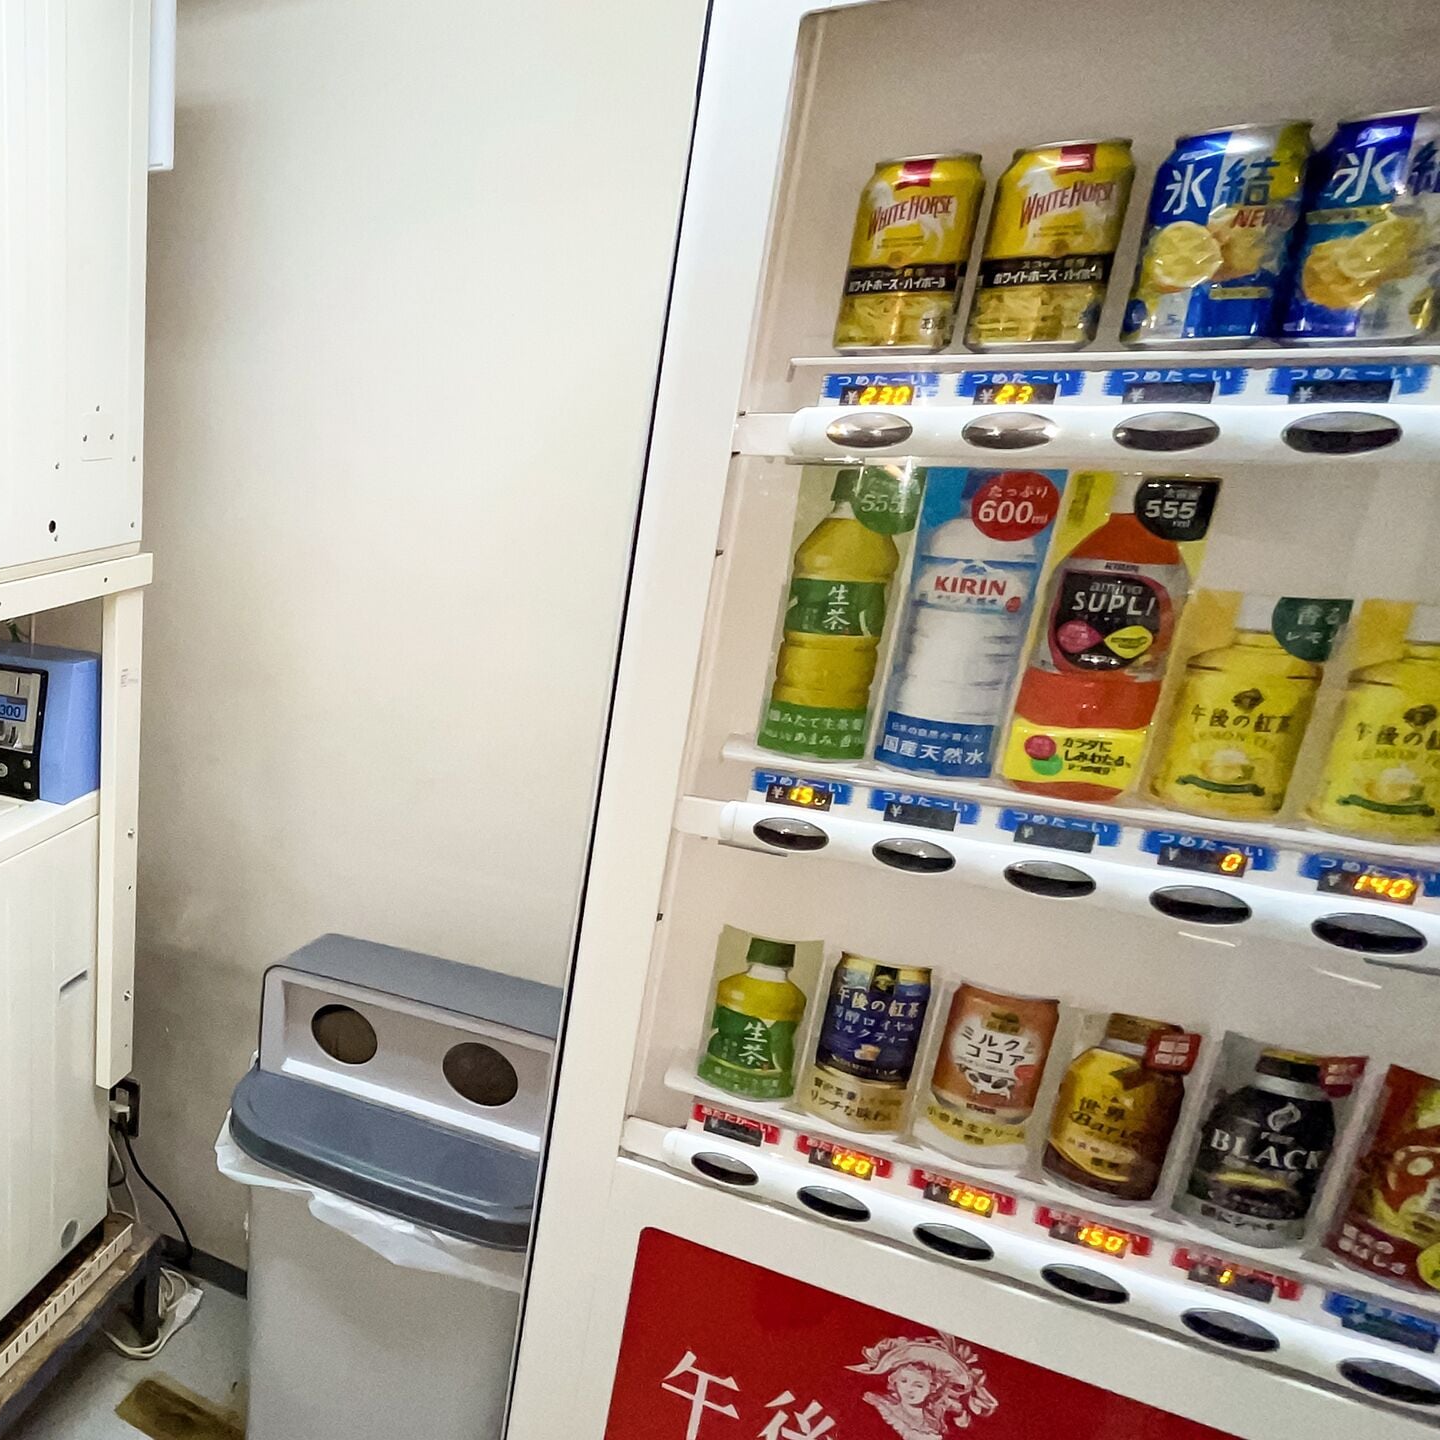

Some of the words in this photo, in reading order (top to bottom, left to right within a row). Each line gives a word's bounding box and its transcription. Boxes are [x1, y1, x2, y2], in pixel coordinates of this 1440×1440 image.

[1162, 157, 1280, 216] 氷結
[867, 201, 910, 241] WHITE
[908, 195, 955, 221] HORSE
[1019, 186, 1071, 230] WHITE
[988, 485, 1049, 499] たっぷり
[1144, 500, 1198, 519] 555
[934, 575, 1007, 596] KIRIN
[1089, 580, 1144, 596] amino
[822, 583, 851, 632] 生茶
[882, 734, 985, 765] 国産天然水
[1062, 737, 1113, 753] カラダに
[1353, 874, 1415, 899] 140
[838, 987, 920, 1019] 午後の紅茶
[738, 1021, 769, 1066] 生茶
[966, 1043, 1025, 1066] ココア
[832, 1152, 871, 1175] 120
[949, 1188, 991, 1212] 130
[1077, 1227, 1124, 1252] 150
